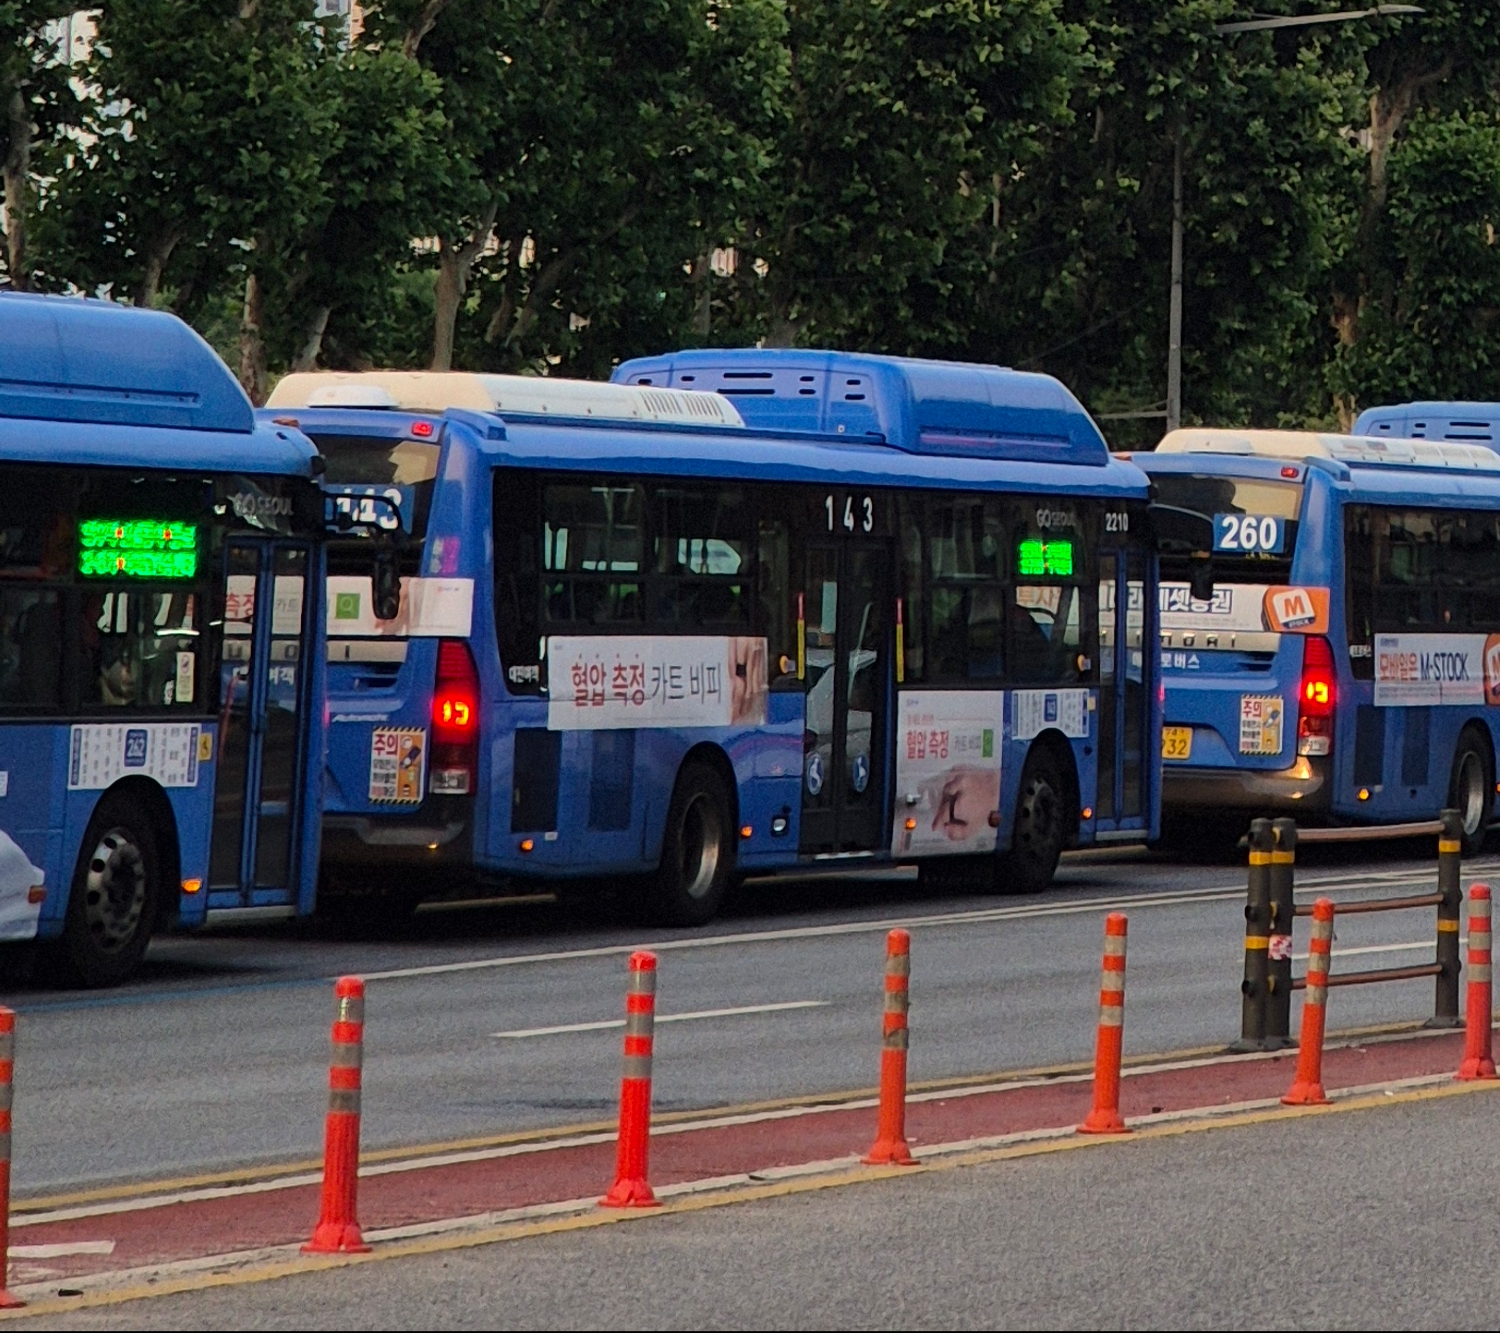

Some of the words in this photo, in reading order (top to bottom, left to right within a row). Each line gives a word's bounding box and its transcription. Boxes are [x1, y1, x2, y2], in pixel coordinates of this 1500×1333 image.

[1105, 513, 1130, 533] 2210
[1220, 516, 1278, 550] 260
[1284, 596, 1306, 618] M
[1420, 652, 1471, 682] M-STOCK
[571, 661, 608, 708] 혈압
[611, 662, 646, 707] 측정
[650, 662, 686, 706] 카트
[688, 661, 722, 706] 비피
[1243, 700, 1262, 719] 주의
[373, 733, 399, 757] 주의
[929, 730, 949, 760] 측정
[1162, 739, 1188, 757] 32
